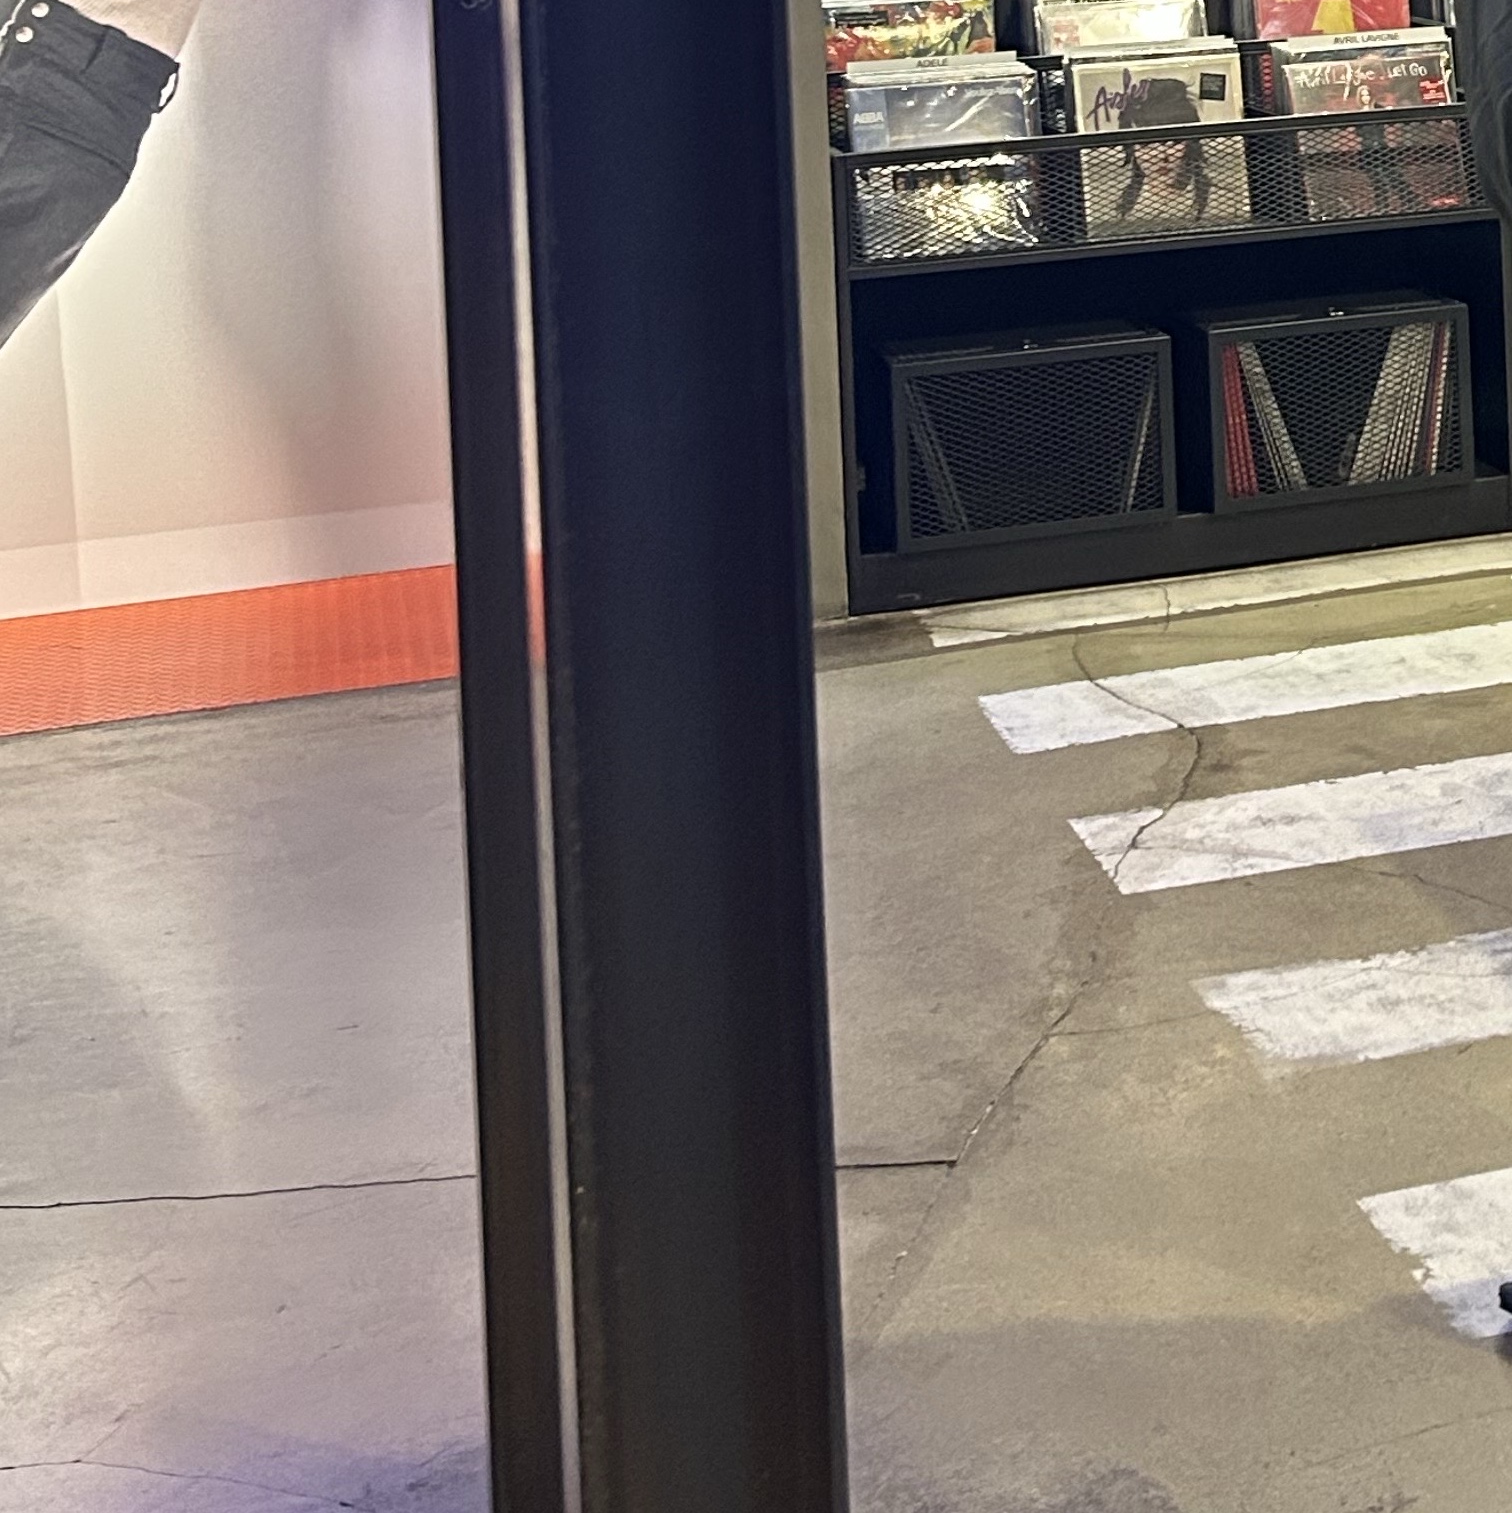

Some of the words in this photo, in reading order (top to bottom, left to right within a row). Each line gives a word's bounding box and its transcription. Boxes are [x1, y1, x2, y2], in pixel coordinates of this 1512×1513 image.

[1333, 36, 1359, 44] AVRIL
[1361, 32, 1400, 43] LAVIGNE
[916, 58, 948, 68] ADELE
